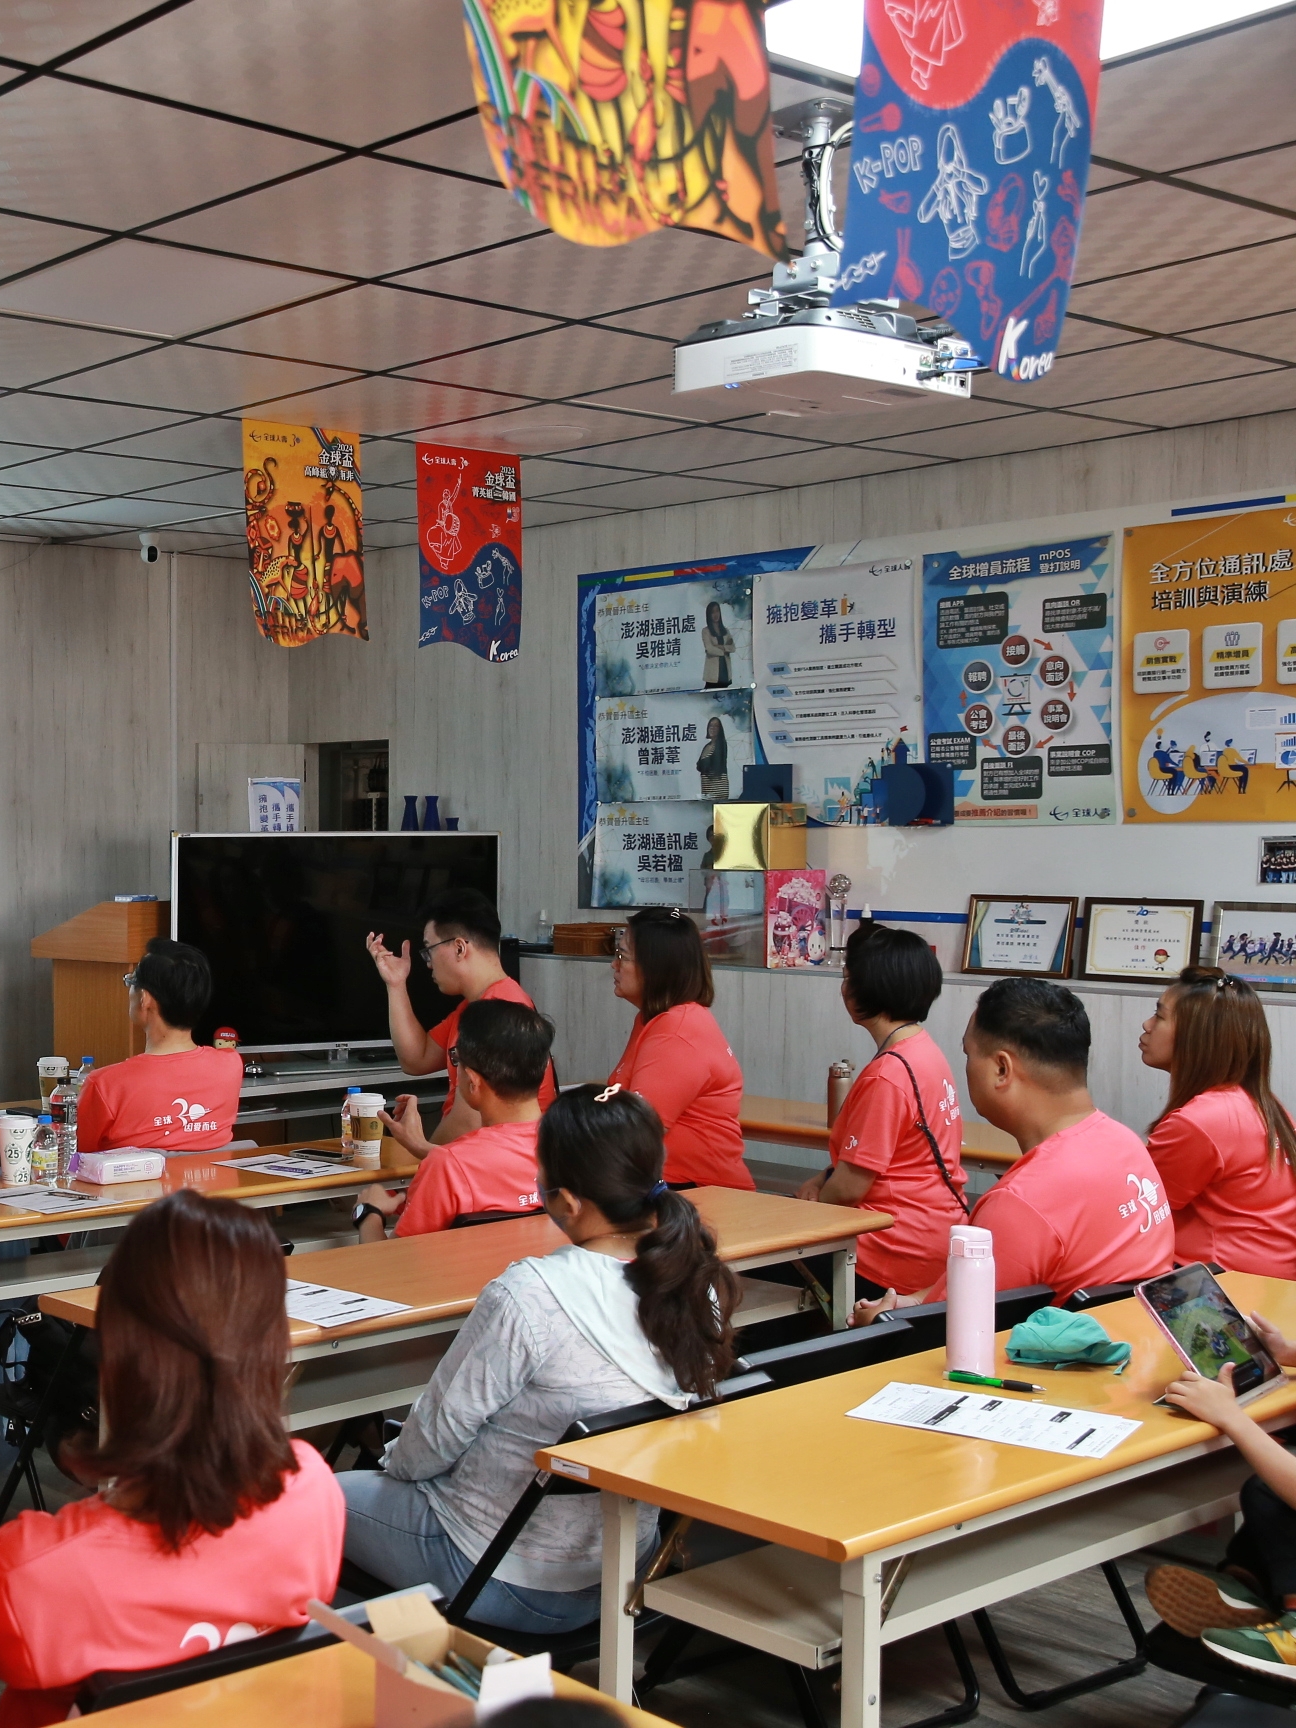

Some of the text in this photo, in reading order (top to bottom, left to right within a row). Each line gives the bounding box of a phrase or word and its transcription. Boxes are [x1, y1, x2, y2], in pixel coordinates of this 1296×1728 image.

[854, 138, 922, 194] K-POP
[998, 317, 1054, 380] Korea
[264, 433, 287, 443] 全球人壽
[337, 443, 353, 452] 2024
[319, 448, 354, 468] 金球盃
[435, 456, 456, 466] 全球人壽
[304, 466, 354, 481] 高峰組 南非
[500, 466, 515, 474] 2024
[485, 471, 516, 489] 金球盃
[1039, 549, 1070, 561] mPOS
[949, 557, 1031, 581] 全球增員流程
[1039, 559, 1080, 574] 登打說明
[1149, 549, 1294, 585] 全方位通訊處
[421, 585, 449, 608] K-POP
[1151, 580, 1270, 611] 培訓與演練
[597, 603, 649, 617] 恭賀晉升區主任
[766, 598, 838, 625] 擁抱變革
[620, 614, 696, 640] 澎湖通訊處
[819, 617, 896, 645] 攜手轉型
[489, 640, 519, 662] Korea
[636, 637, 681, 660] 吳雅靖
[1006, 644, 1025, 656] 接觸
[1216, 649, 1249, 659] 精準增員
[1046, 661, 1064, 670] 意向
[968, 671, 987, 682] 報聘
[1046, 672, 1064, 682] 面談
[970, 709, 987, 719] 公會
[1047, 704, 1064, 713] 事業
[598, 709, 648, 721] 恭賀晉升區主任
[1044, 714, 1068, 723] 說明會
[970, 720, 988, 729] 考試
[621, 723, 697, 745] 澎湖通訊處
[1008, 731, 1025, 740] 最後
[1007, 741, 1025, 751] 面談
[1082, 749, 1096, 757] COP
[598, 816, 649, 827] 恭賀晉升區主任
[622, 831, 698, 850] 澎湖通訊處
[153, 1114, 173, 1127] 全球
[184, 1120, 218, 1132] 因愛而在
[7, 1149, 20, 1159] 25
[18, 1173, 28, 1182] 25
[1118, 1199, 1138, 1219] 全球
